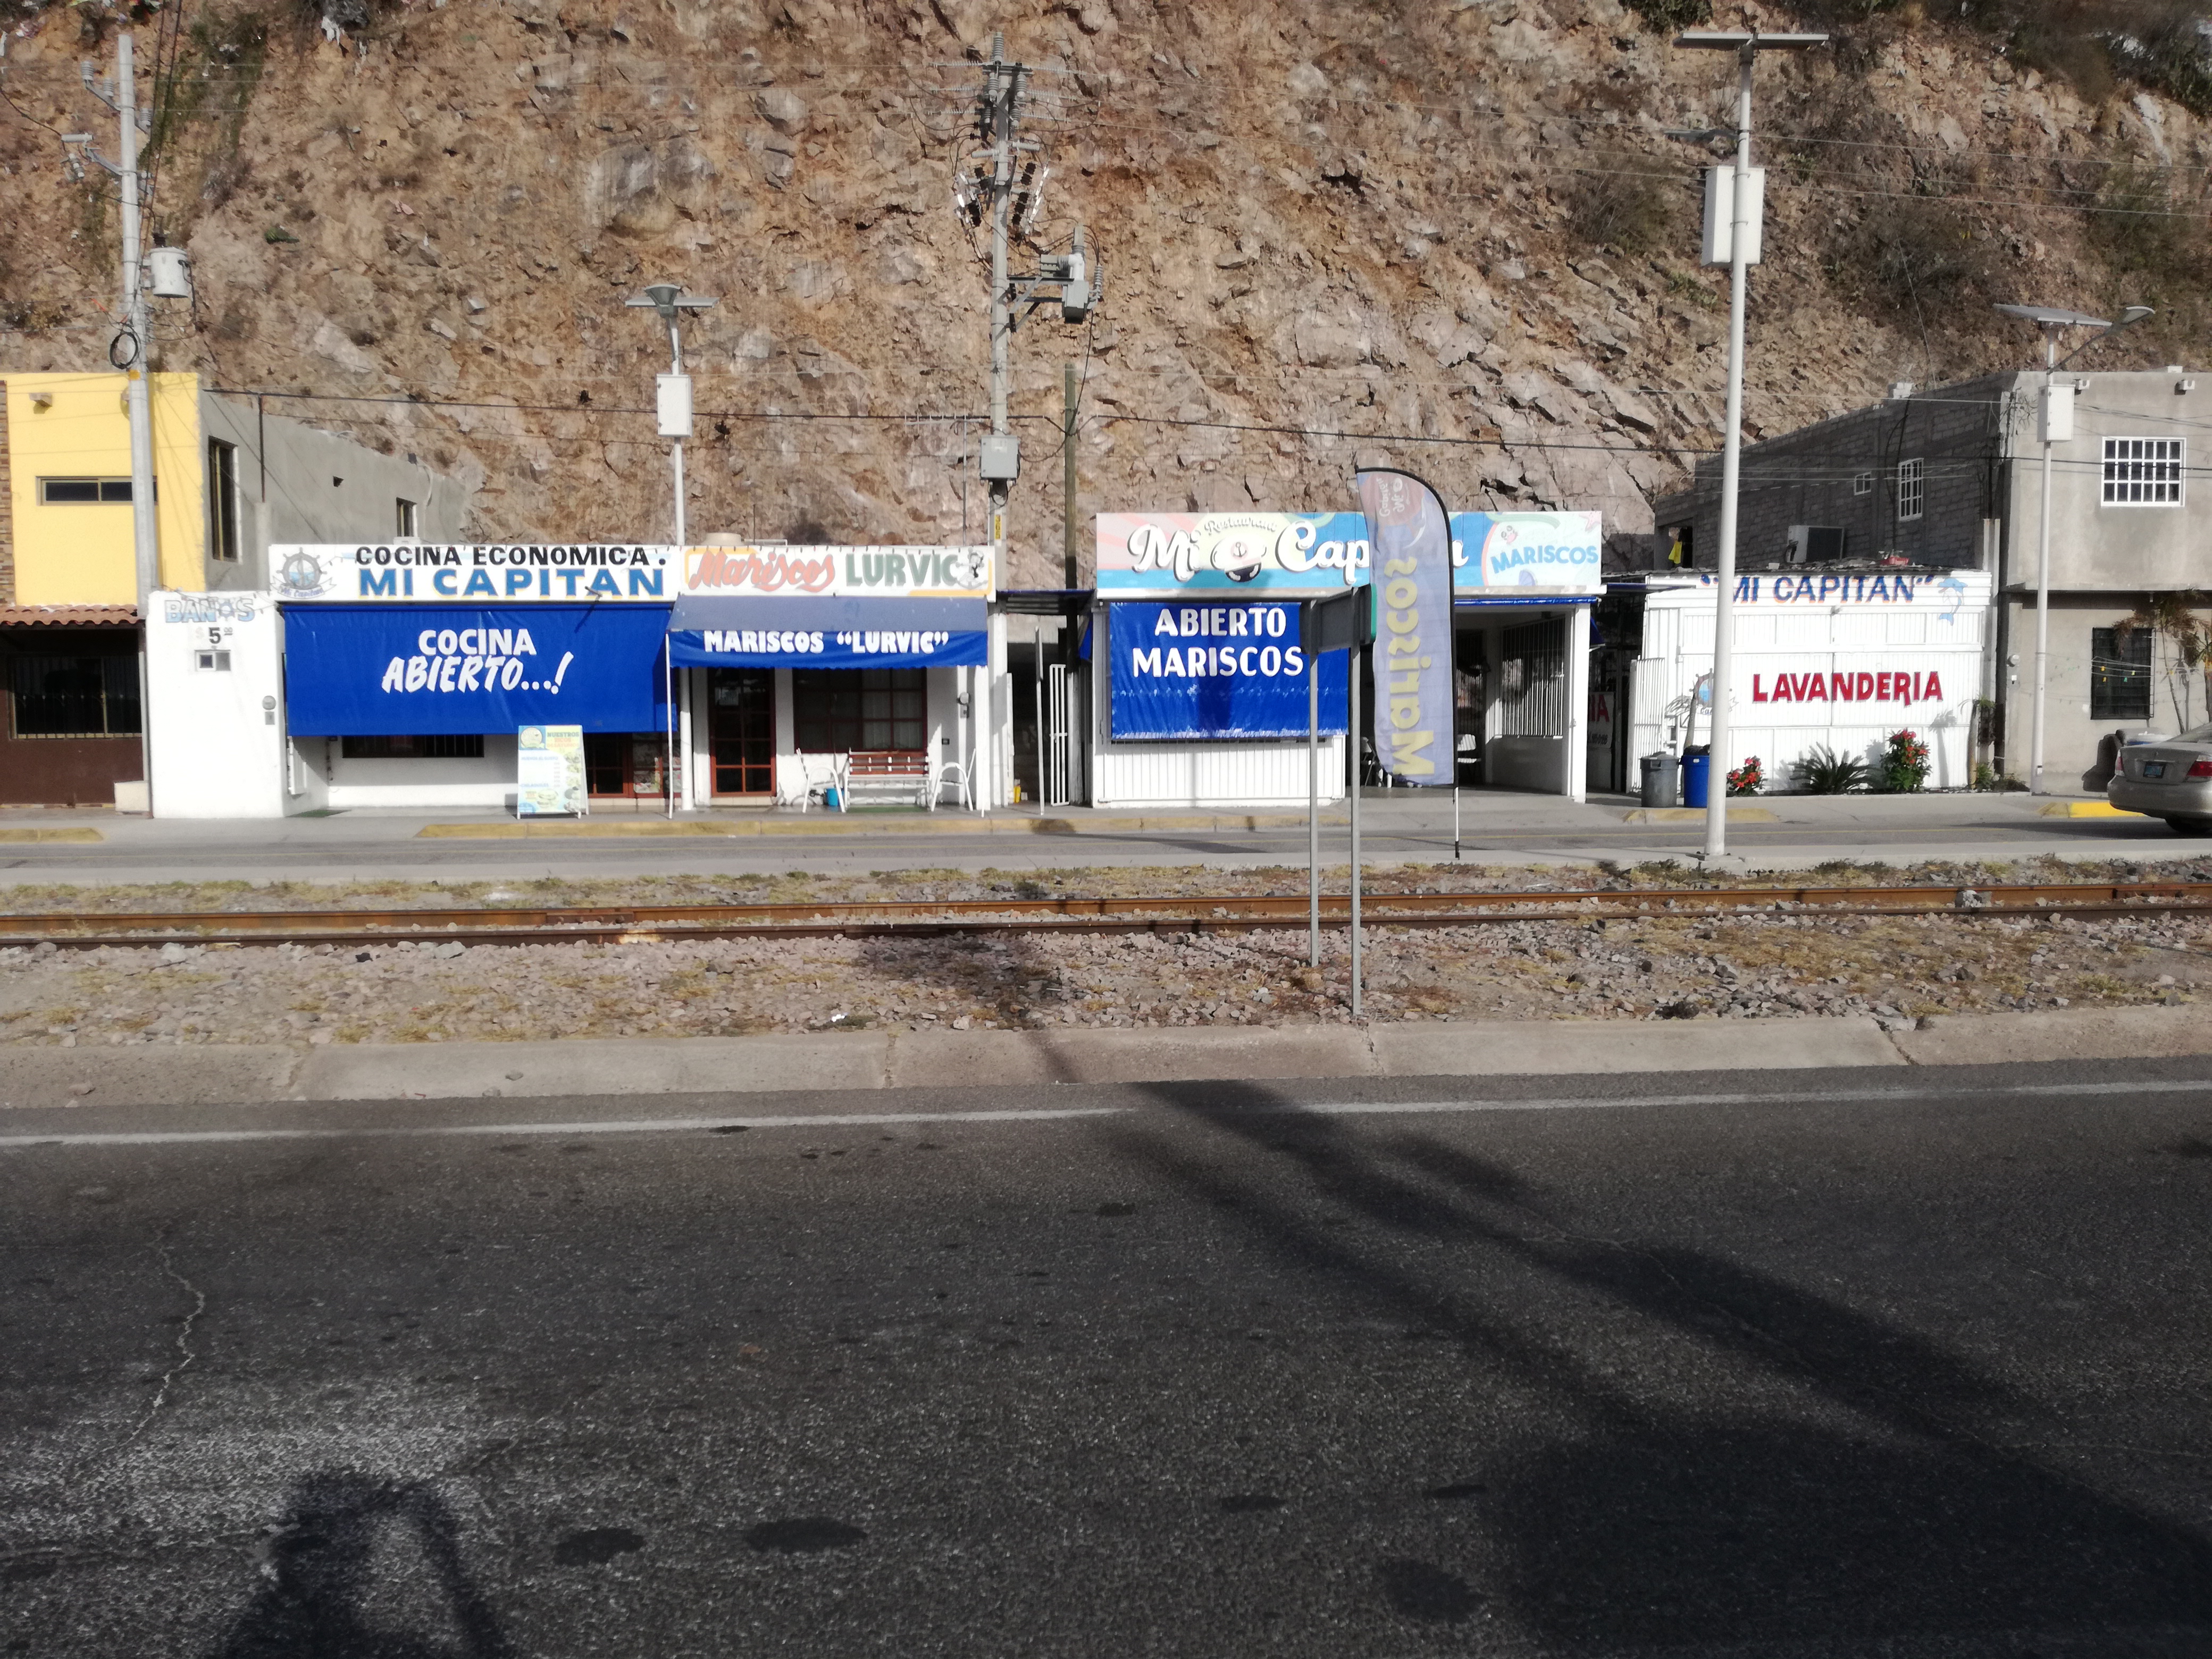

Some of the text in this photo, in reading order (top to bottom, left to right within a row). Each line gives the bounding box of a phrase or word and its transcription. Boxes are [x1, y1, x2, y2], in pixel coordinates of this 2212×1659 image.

[1204, 516, 1277, 536] Restaurant
[356, 546, 461, 566] COCINA
[1127, 524, 1203, 582] Mi
[1490, 545, 1598, 574] MARISCOS
[358, 567, 665, 598] MI CAPITAN
[688, 549, 959, 592] Mariscos LURVIC
[1154, 607, 1287, 637] ABIERTO
[418, 628, 537, 656] COCINA
[703, 630, 824, 653] MARISCOS
[1132, 645, 1304, 678] MARISCOS
[1752, 671, 1944, 707] LAVANDERIA
